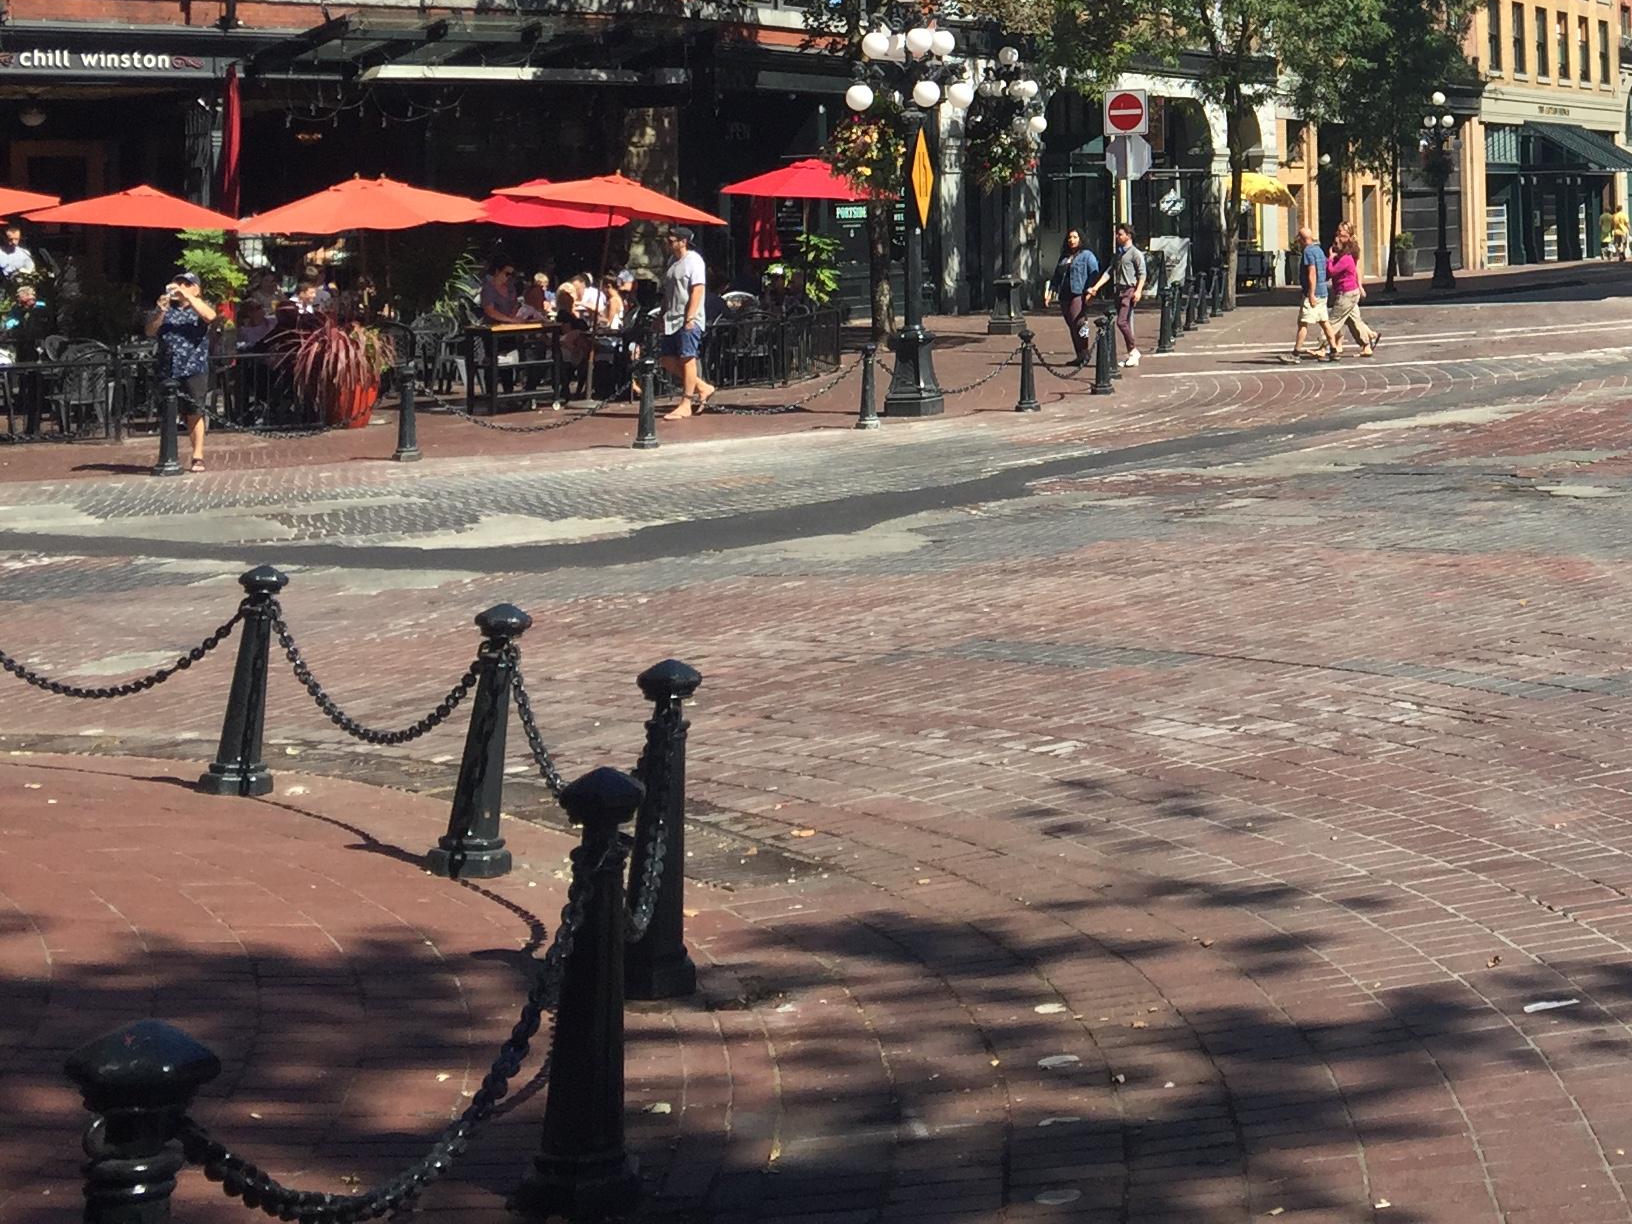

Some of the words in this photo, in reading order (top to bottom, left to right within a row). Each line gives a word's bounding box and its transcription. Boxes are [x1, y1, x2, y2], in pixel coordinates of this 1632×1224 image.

[19, 48, 70, 67] chill
[81, 51, 170, 68] winston
[835, 206, 868, 219] PORTSIDE
